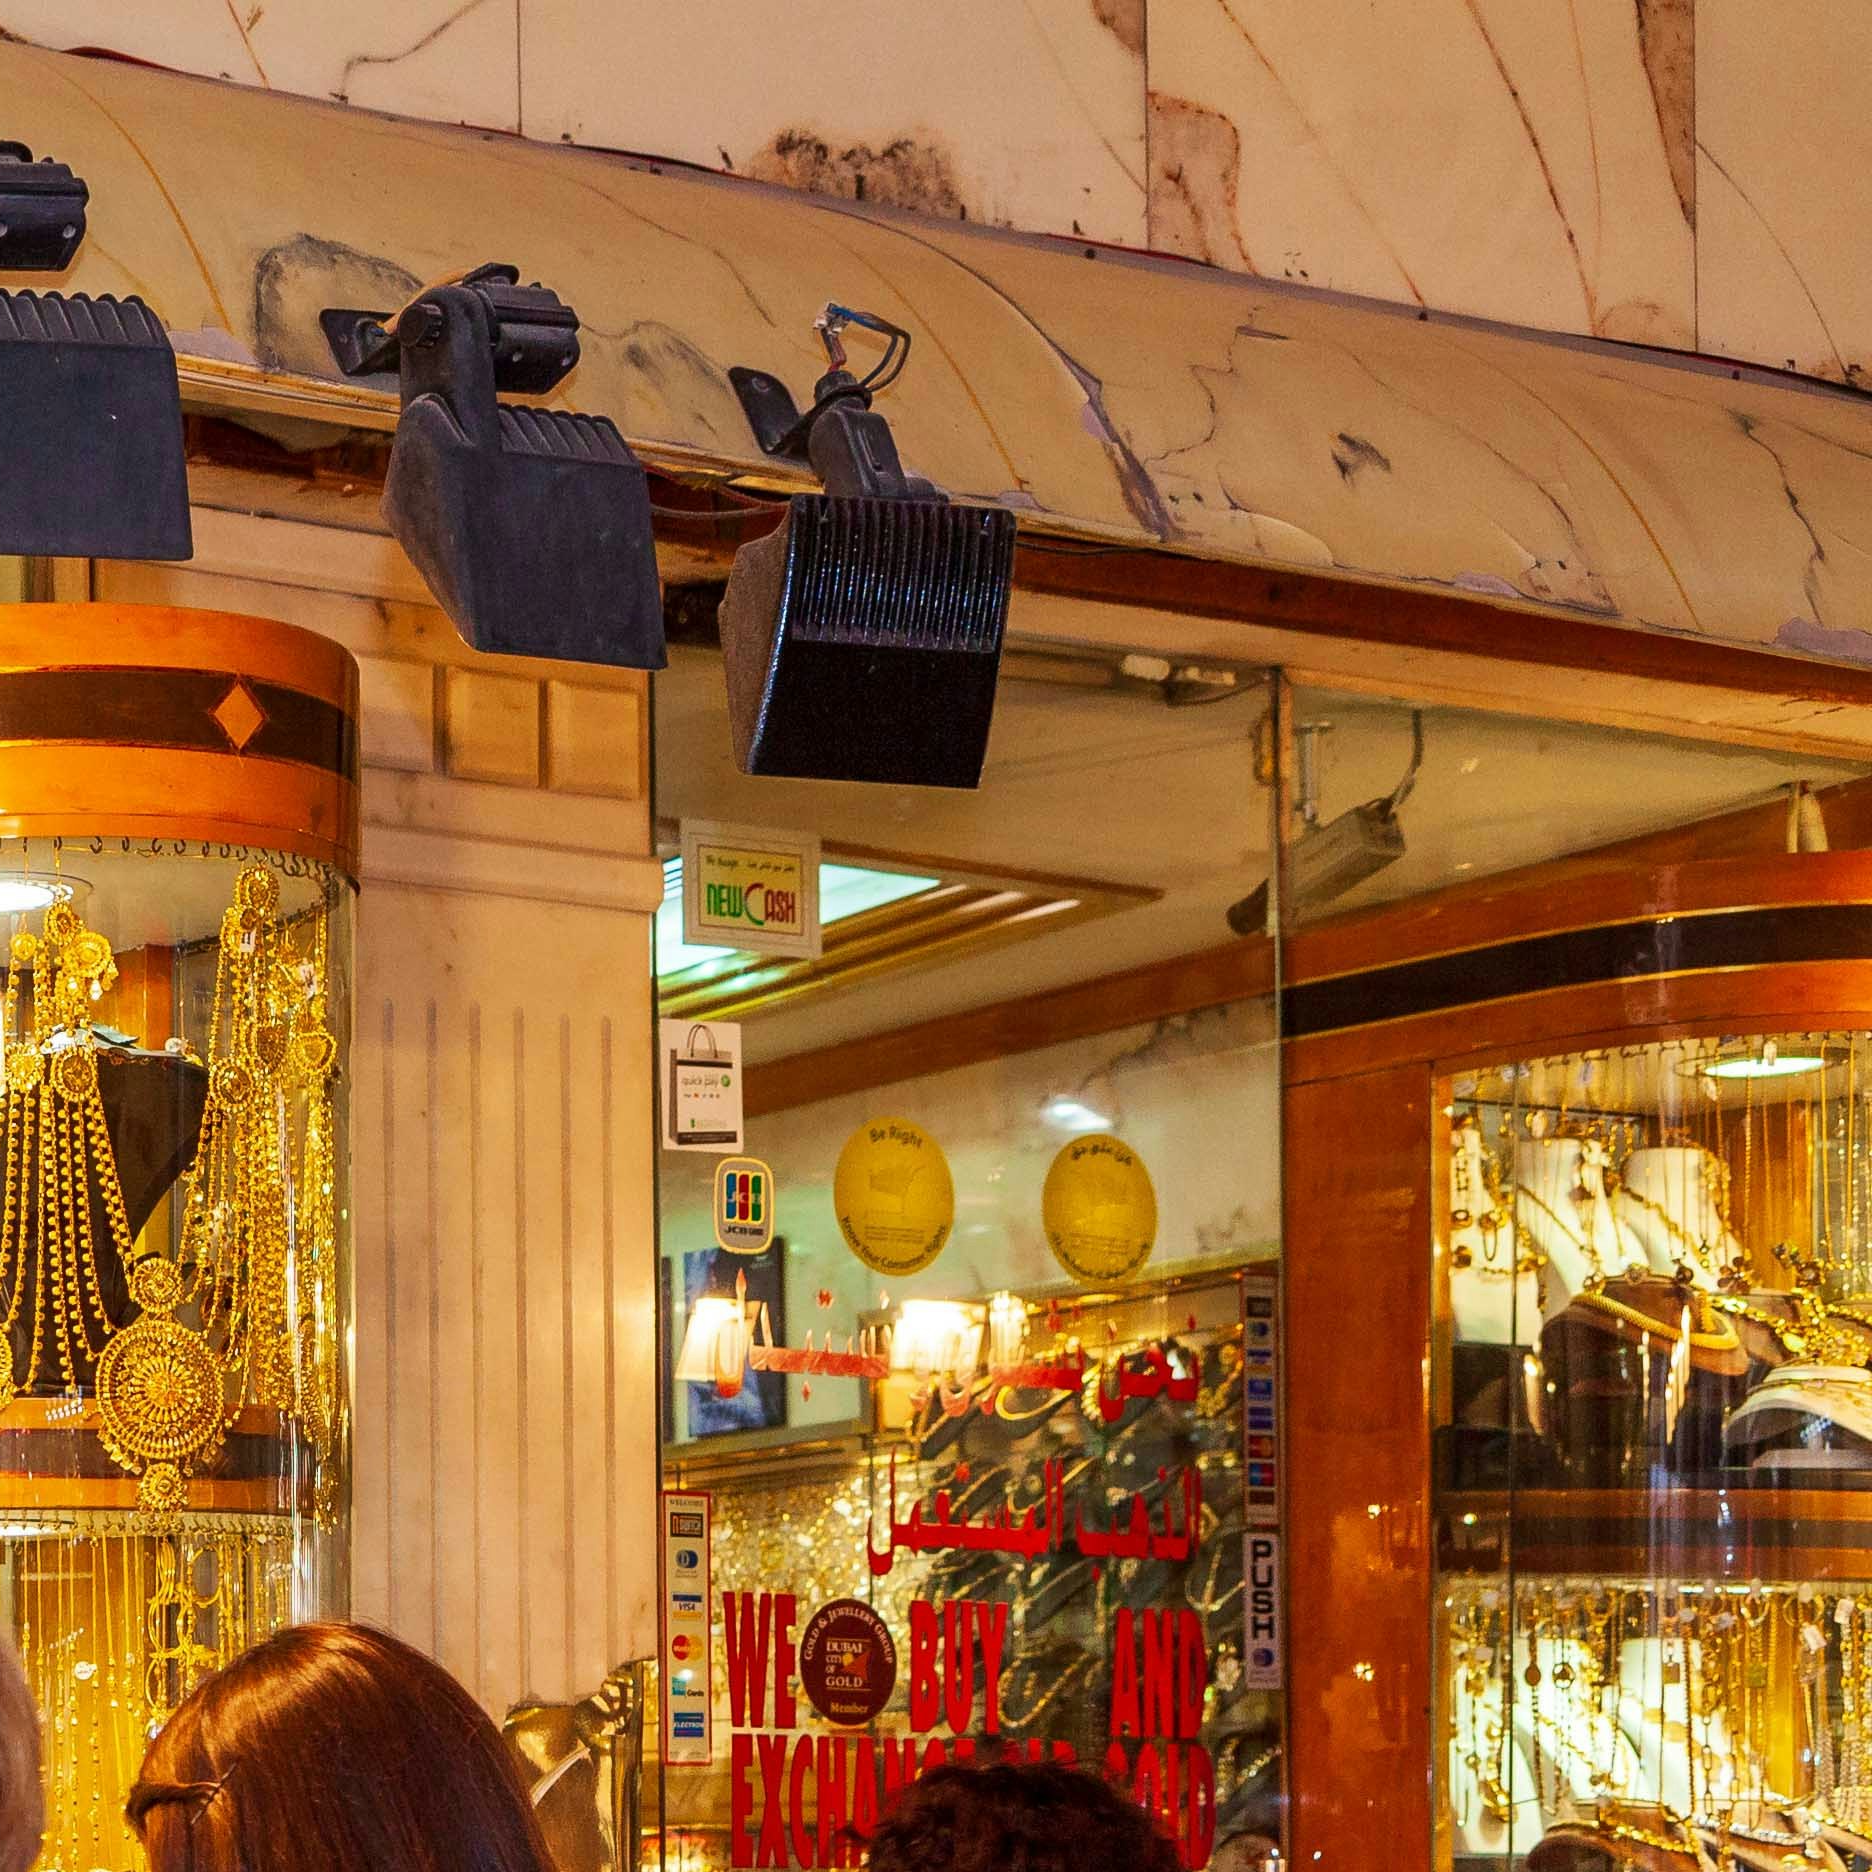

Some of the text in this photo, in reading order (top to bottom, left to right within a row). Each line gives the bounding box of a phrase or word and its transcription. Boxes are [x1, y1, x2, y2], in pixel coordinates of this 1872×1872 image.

[869, 1125, 924, 1149] Be Right
[727, 1191, 764, 1204] JCB
[866, 1448, 1203, 1580] الذهب المستعمل
[1251, 1539, 1275, 1640] PUSH
[804, 1606, 895, 1665] GOLD & JEWELLERY GROUP
[826, 1641, 863, 1654] DUBAI
[723, 1592, 1208, 1740] WE BUY AND
[825, 1676, 863, 1688] GOLD
[830, 1702, 869, 1713] Member
